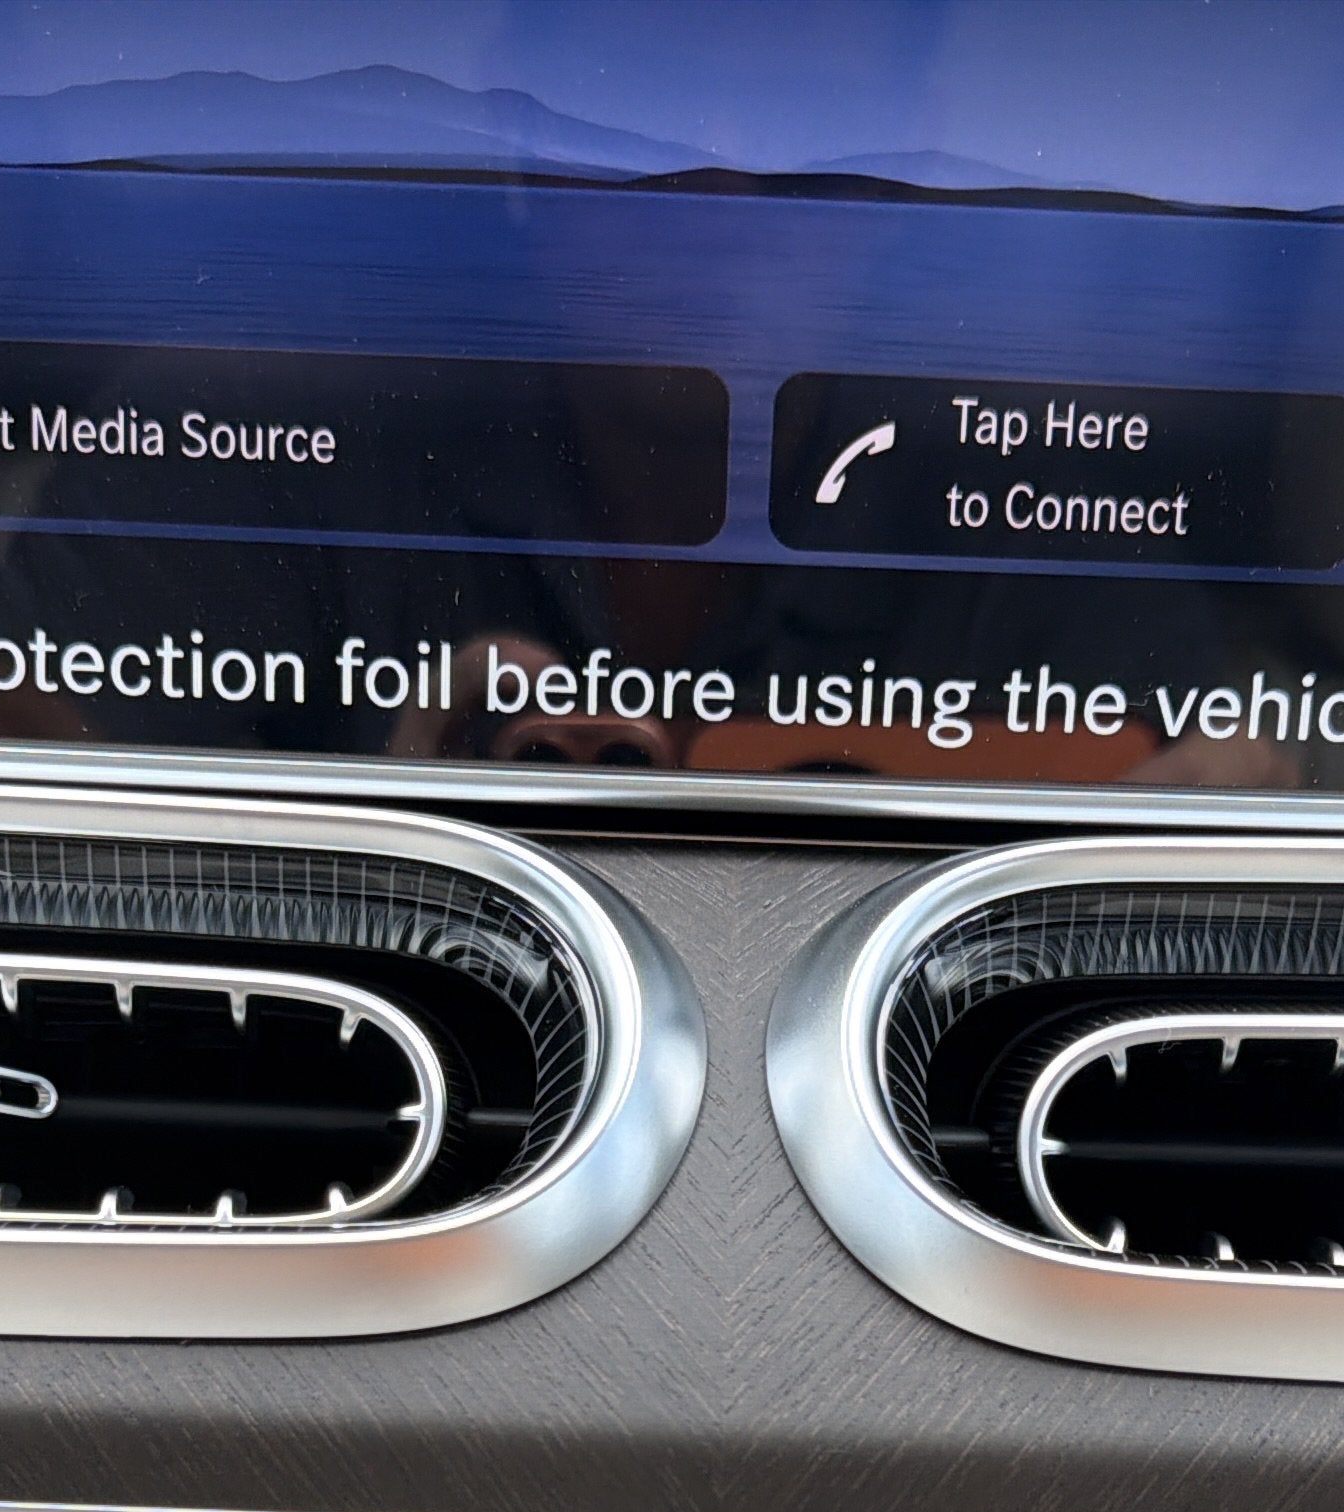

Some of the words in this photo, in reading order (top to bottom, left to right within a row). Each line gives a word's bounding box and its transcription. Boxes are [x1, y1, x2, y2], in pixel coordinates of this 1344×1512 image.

[31, 406, 164, 456] Media
[181, 412, 336, 464] Source
[952, 398, 1028, 456] Tap
[1045, 402, 1149, 451] Here
[946, 485, 989, 528] to
[1005, 484, 1189, 535] Connect
[335, 638, 451, 710] foil
[486, 644, 735, 722] before
[768, 659, 977, 749] using
[1003, 665, 1127, 736] the
